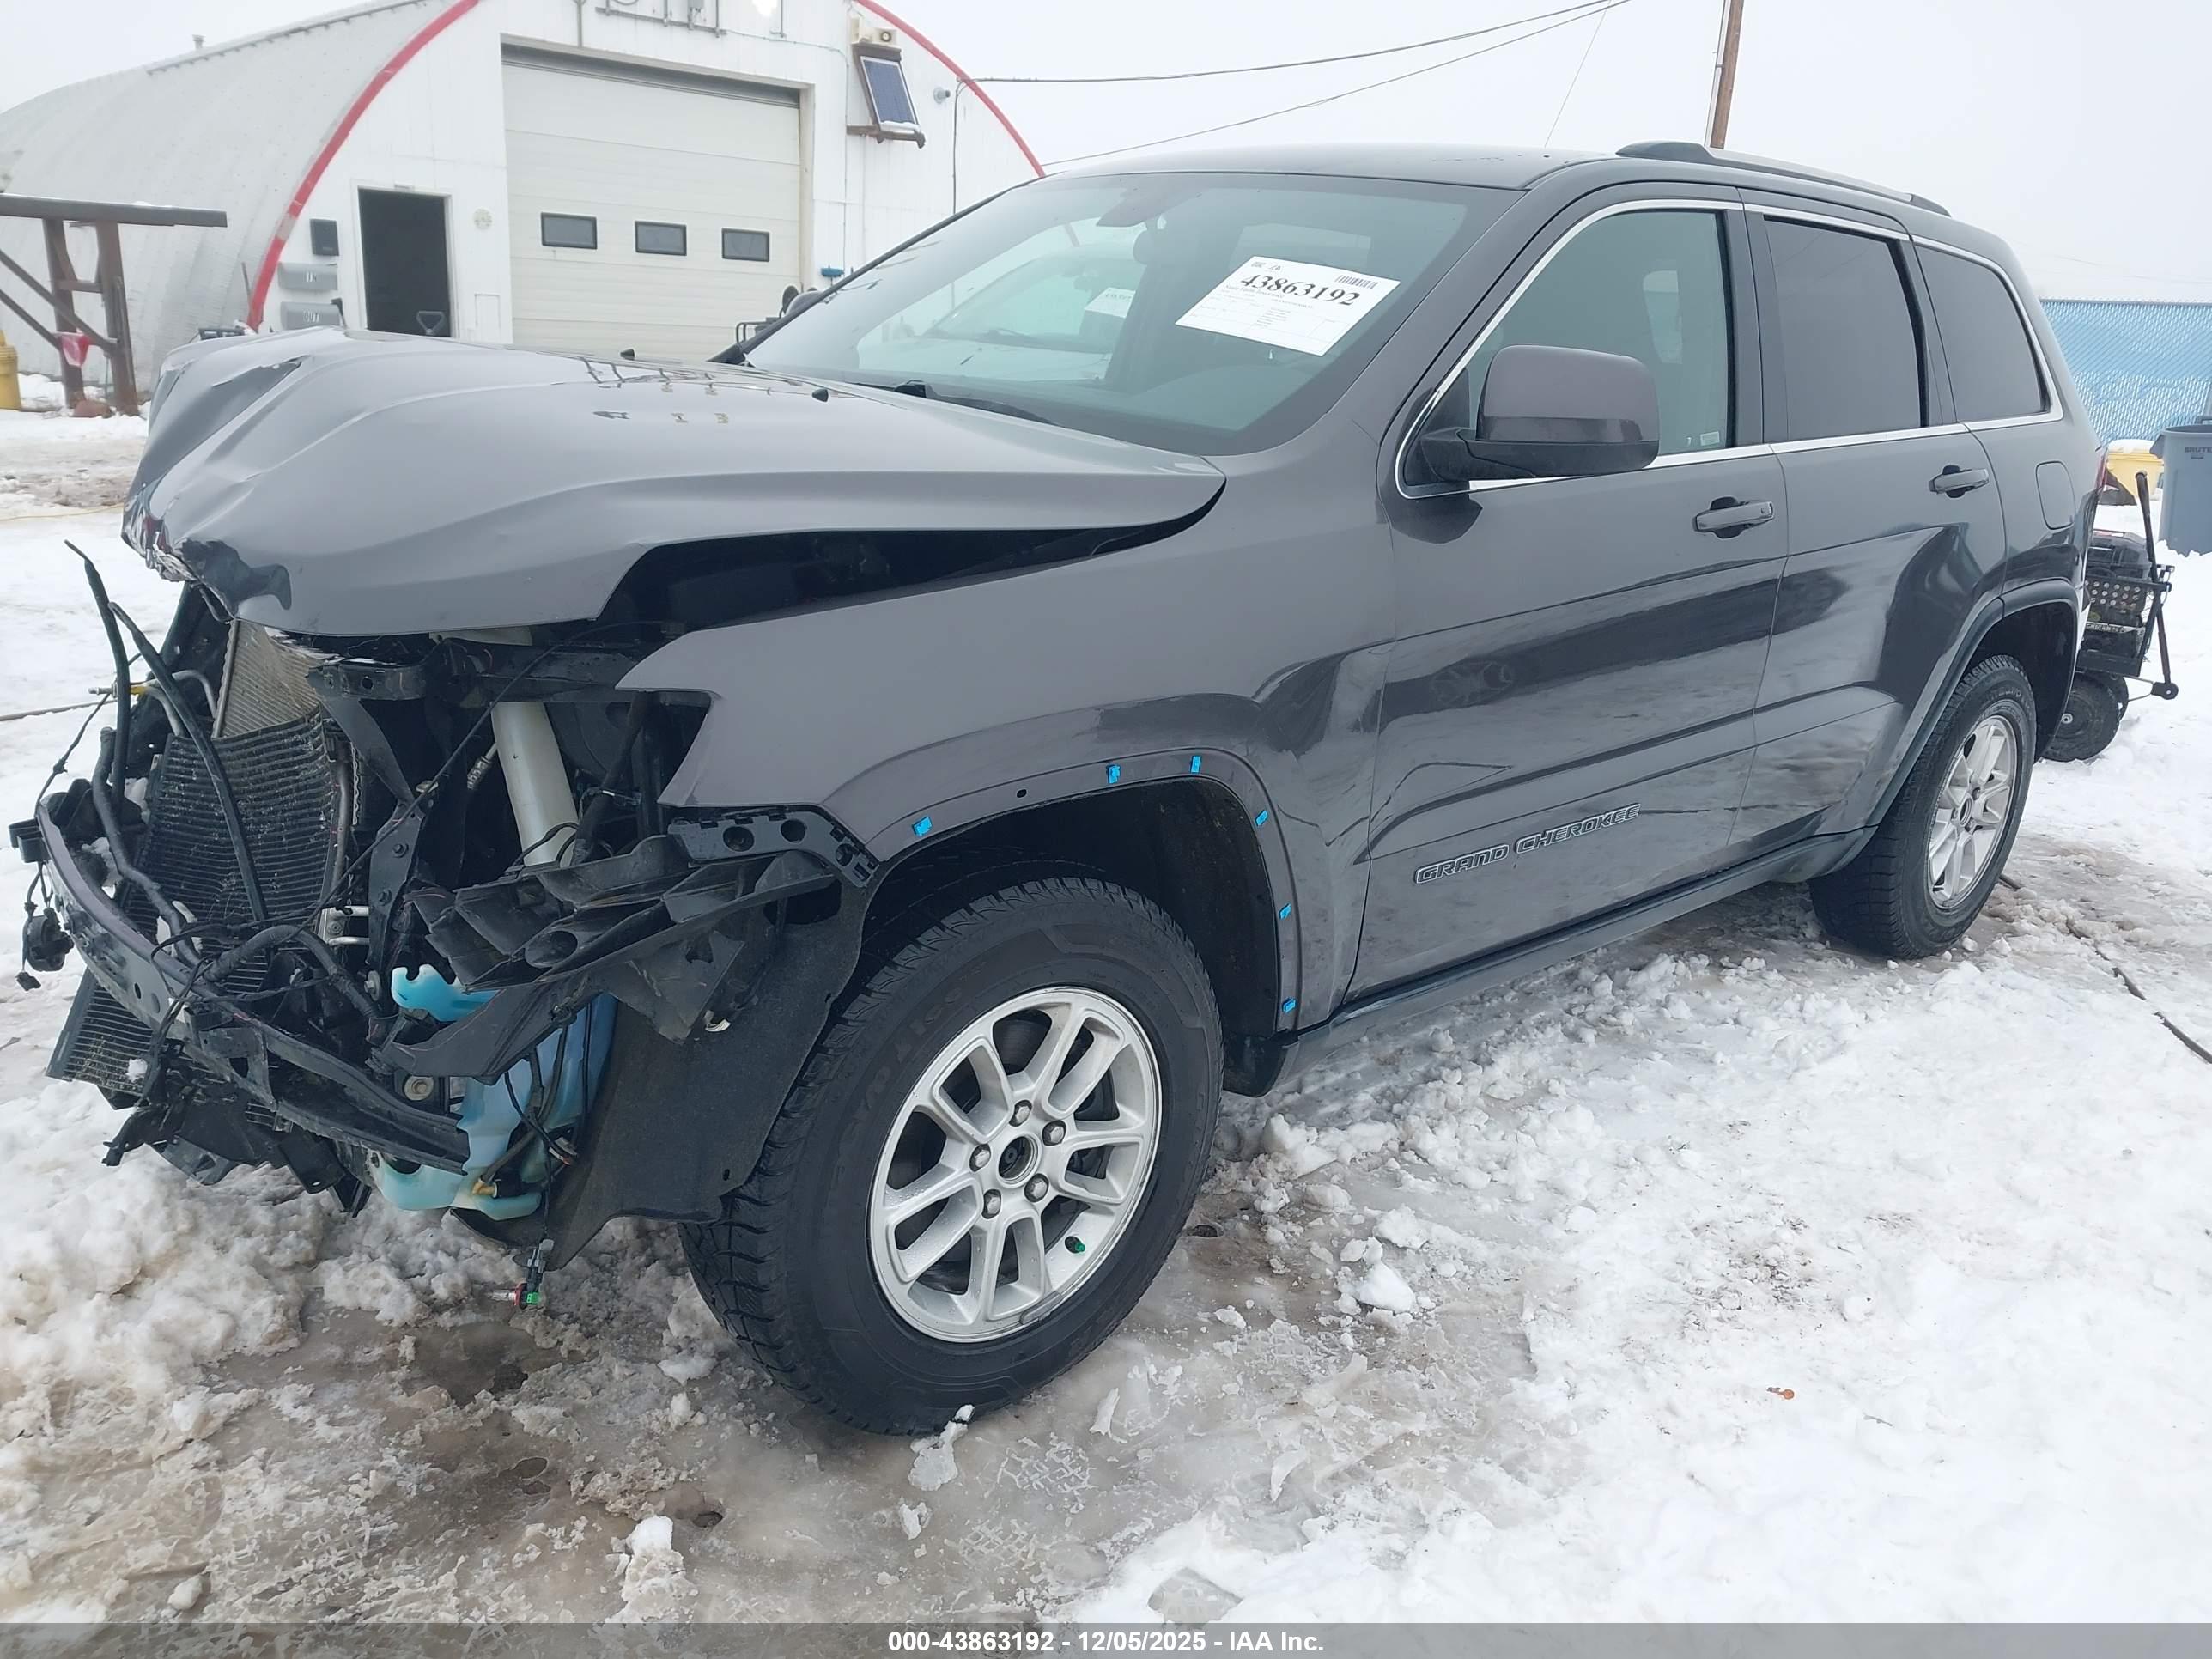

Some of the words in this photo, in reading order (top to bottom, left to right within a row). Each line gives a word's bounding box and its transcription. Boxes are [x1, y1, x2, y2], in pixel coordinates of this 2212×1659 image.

[1241, 274, 1360, 306] 43863192
[1413, 844, 1510, 884] GRAND
[1514, 803, 1641, 854] CHEROKEE
